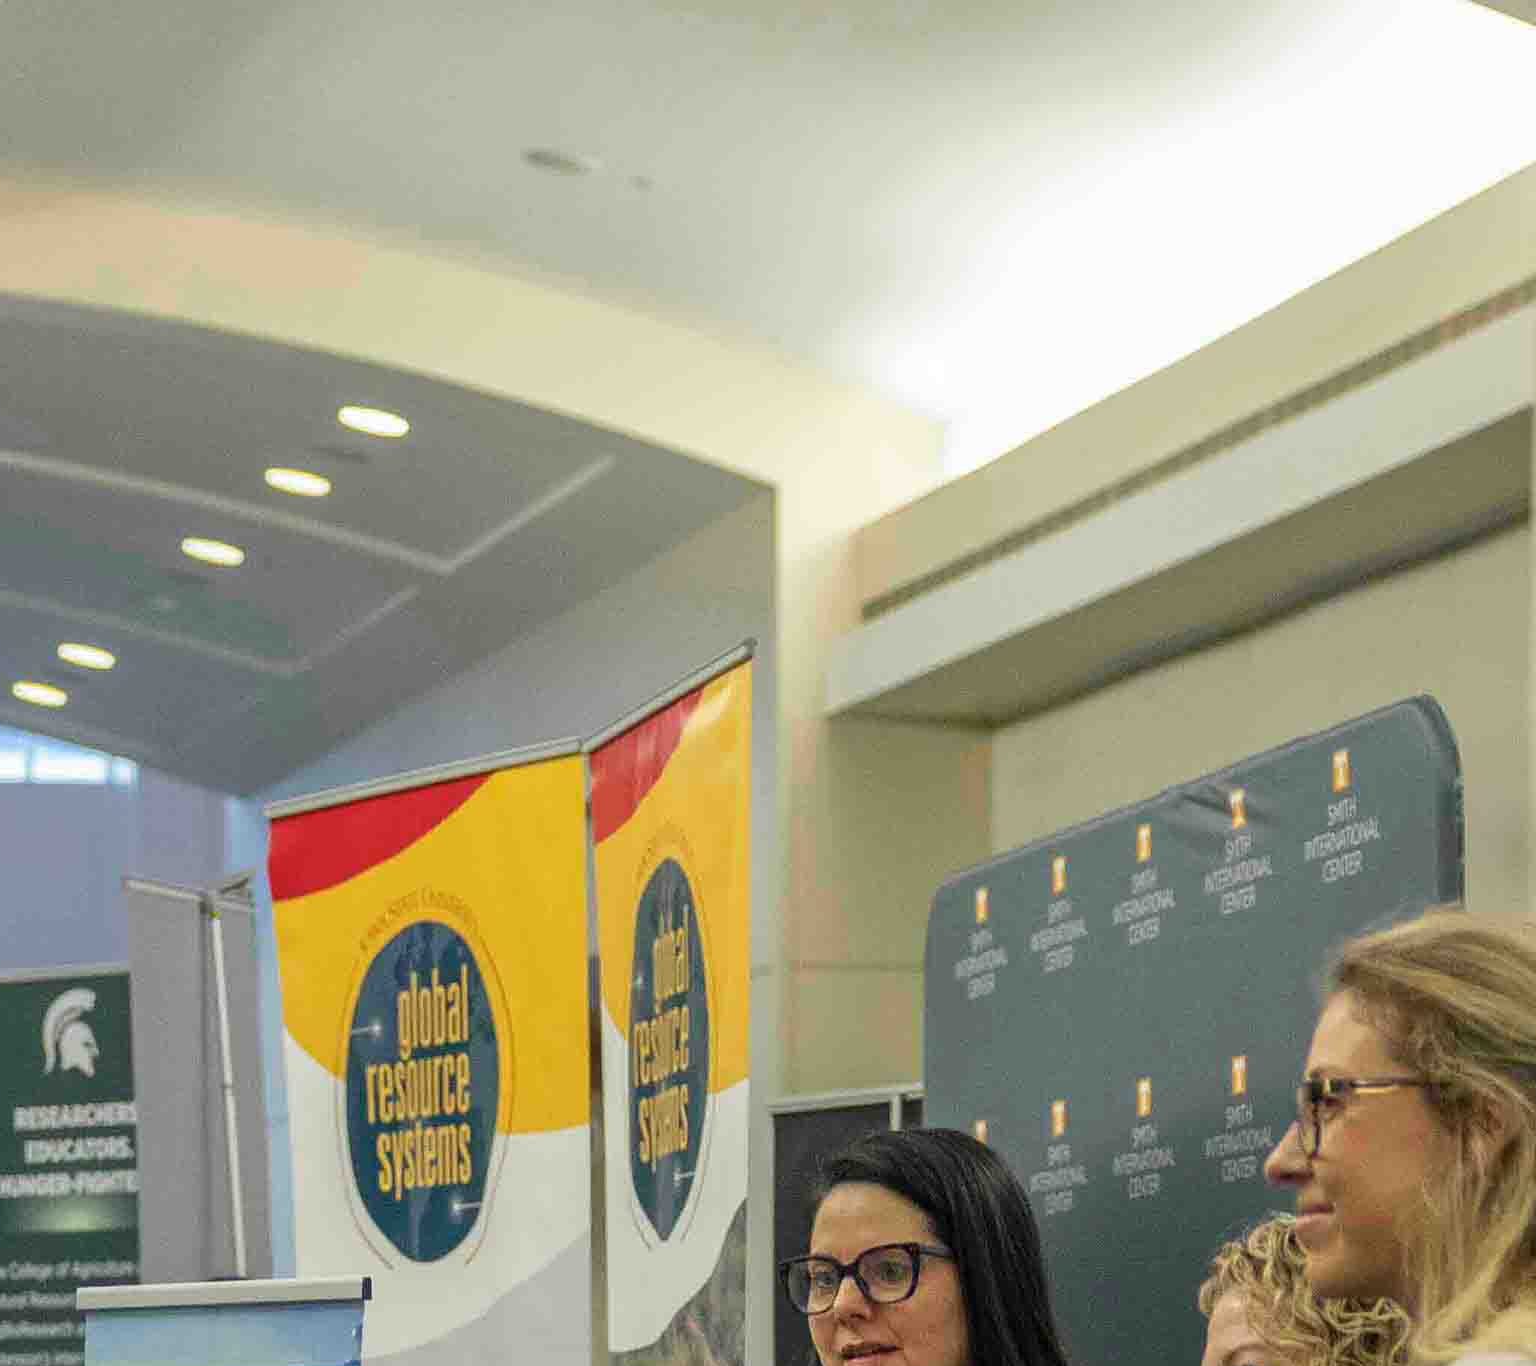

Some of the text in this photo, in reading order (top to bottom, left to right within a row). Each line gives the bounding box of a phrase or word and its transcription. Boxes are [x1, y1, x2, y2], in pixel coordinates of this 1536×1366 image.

[397, 965, 468, 1060] global
[366, 1049, 470, 1125] resource
[377, 1122, 472, 1200] systems
